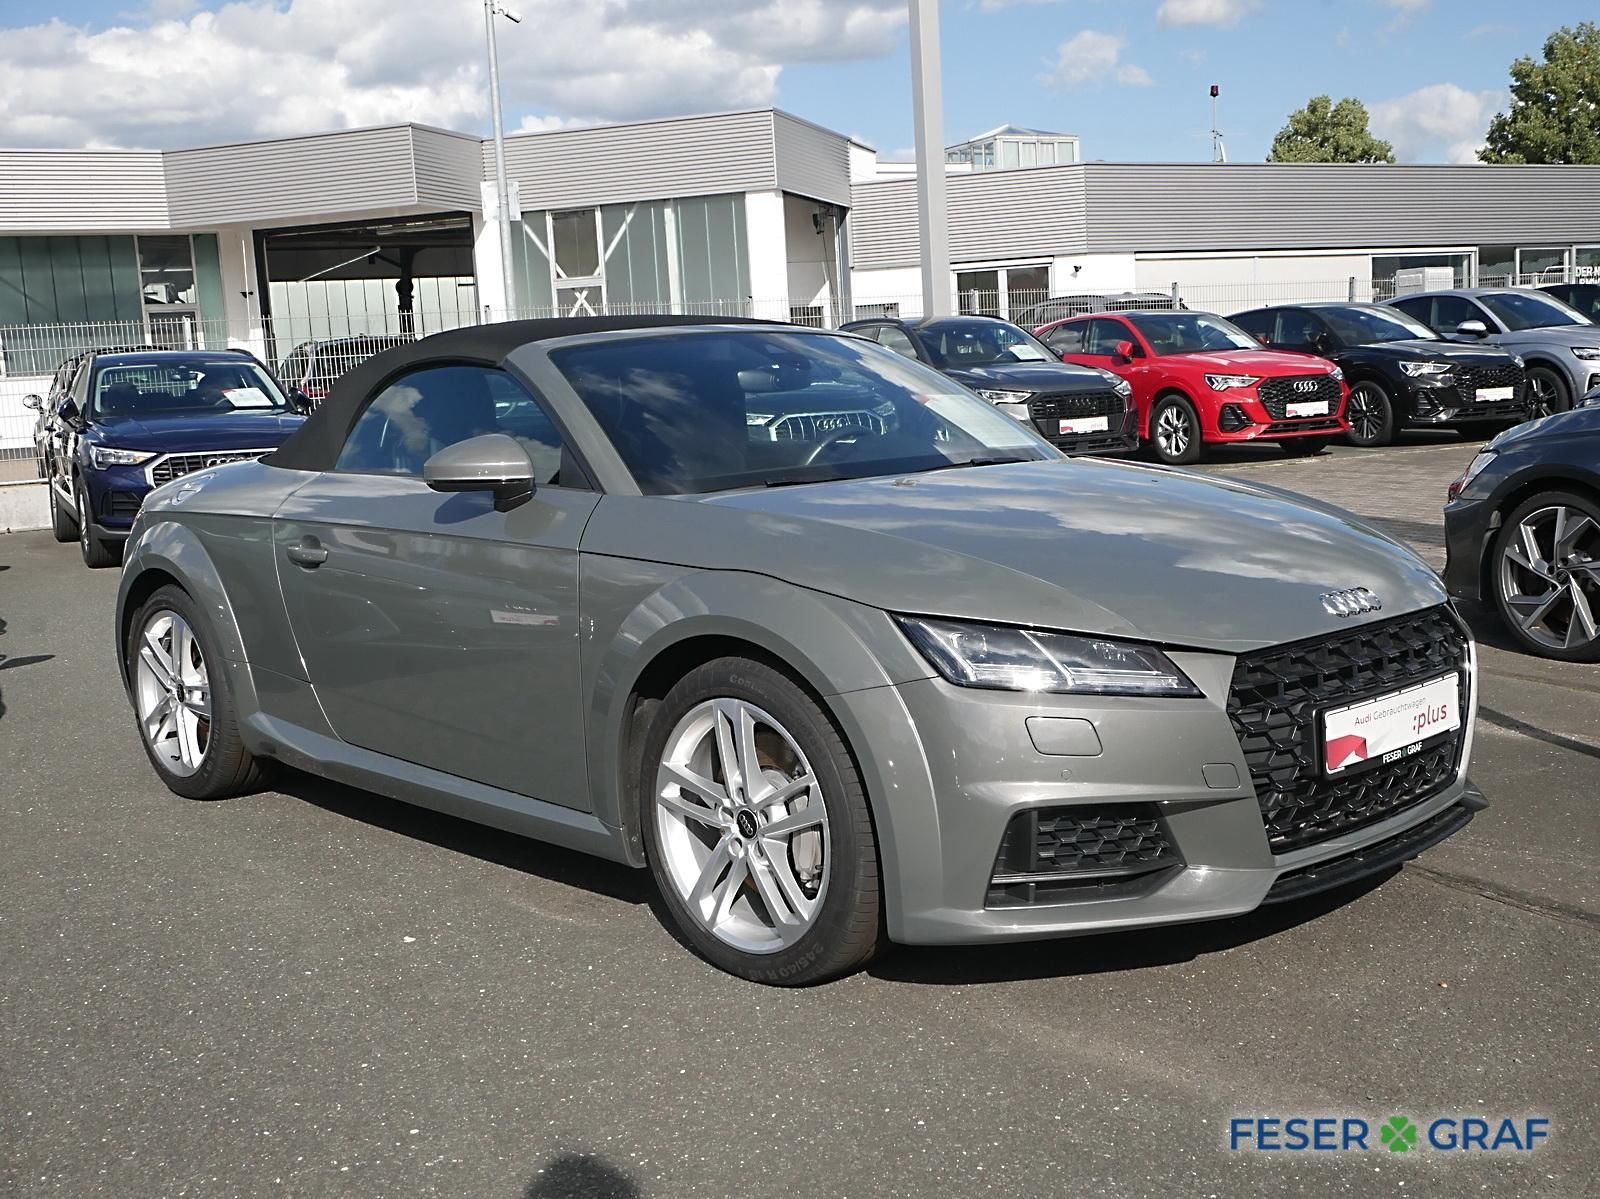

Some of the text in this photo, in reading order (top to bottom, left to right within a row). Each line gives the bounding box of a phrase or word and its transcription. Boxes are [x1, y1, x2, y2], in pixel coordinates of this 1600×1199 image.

[1354, 697, 1426, 726] Audi Gebrauchtwagen
[1413, 704, 1447, 734] :plus
[1382, 742, 1423, 764] FESER GRAF
